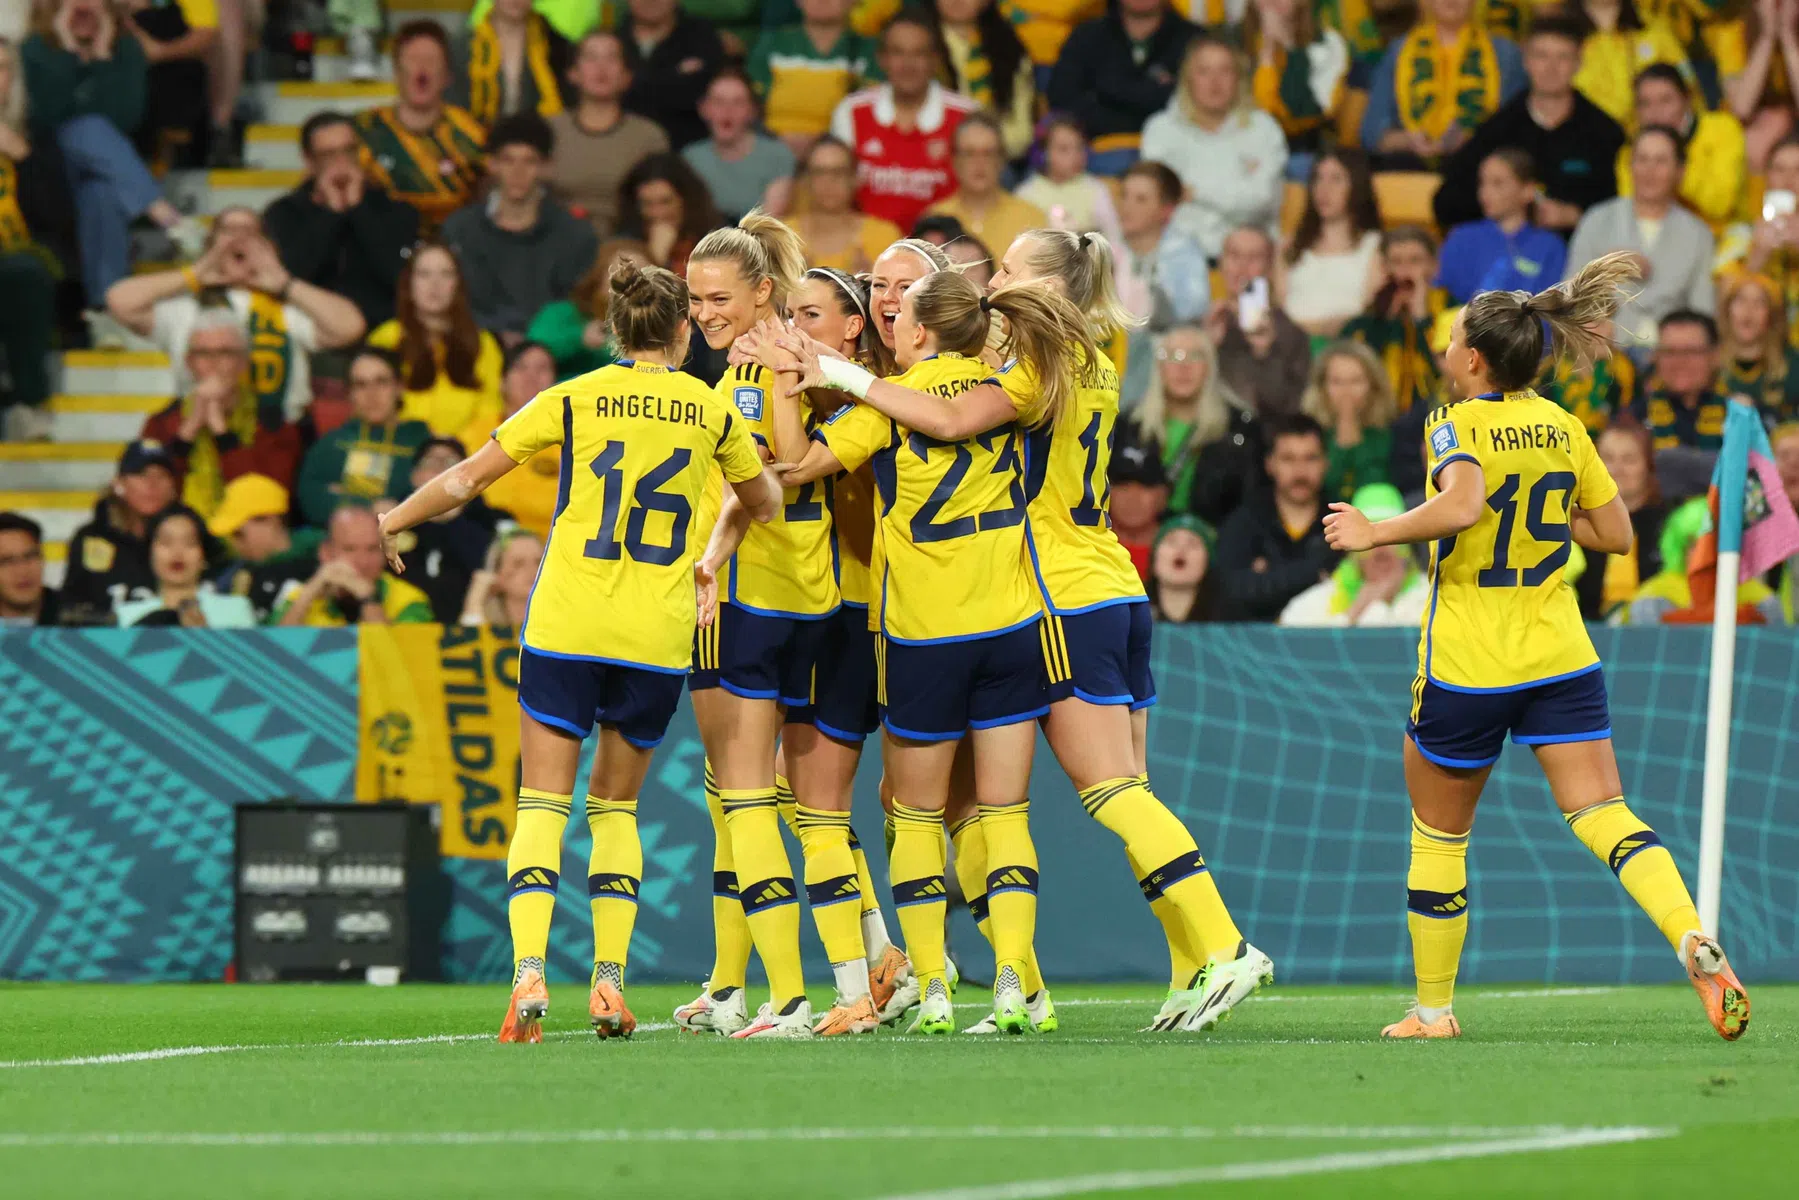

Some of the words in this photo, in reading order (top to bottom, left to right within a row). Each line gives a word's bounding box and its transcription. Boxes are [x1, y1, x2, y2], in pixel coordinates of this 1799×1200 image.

[597, 395, 707, 429] ANGELDAL
[1070, 411, 1114, 529] 1
[583, 440, 692, 566] 16
[909, 421, 1027, 543] 23
[1478, 471, 1577, 587] 19
